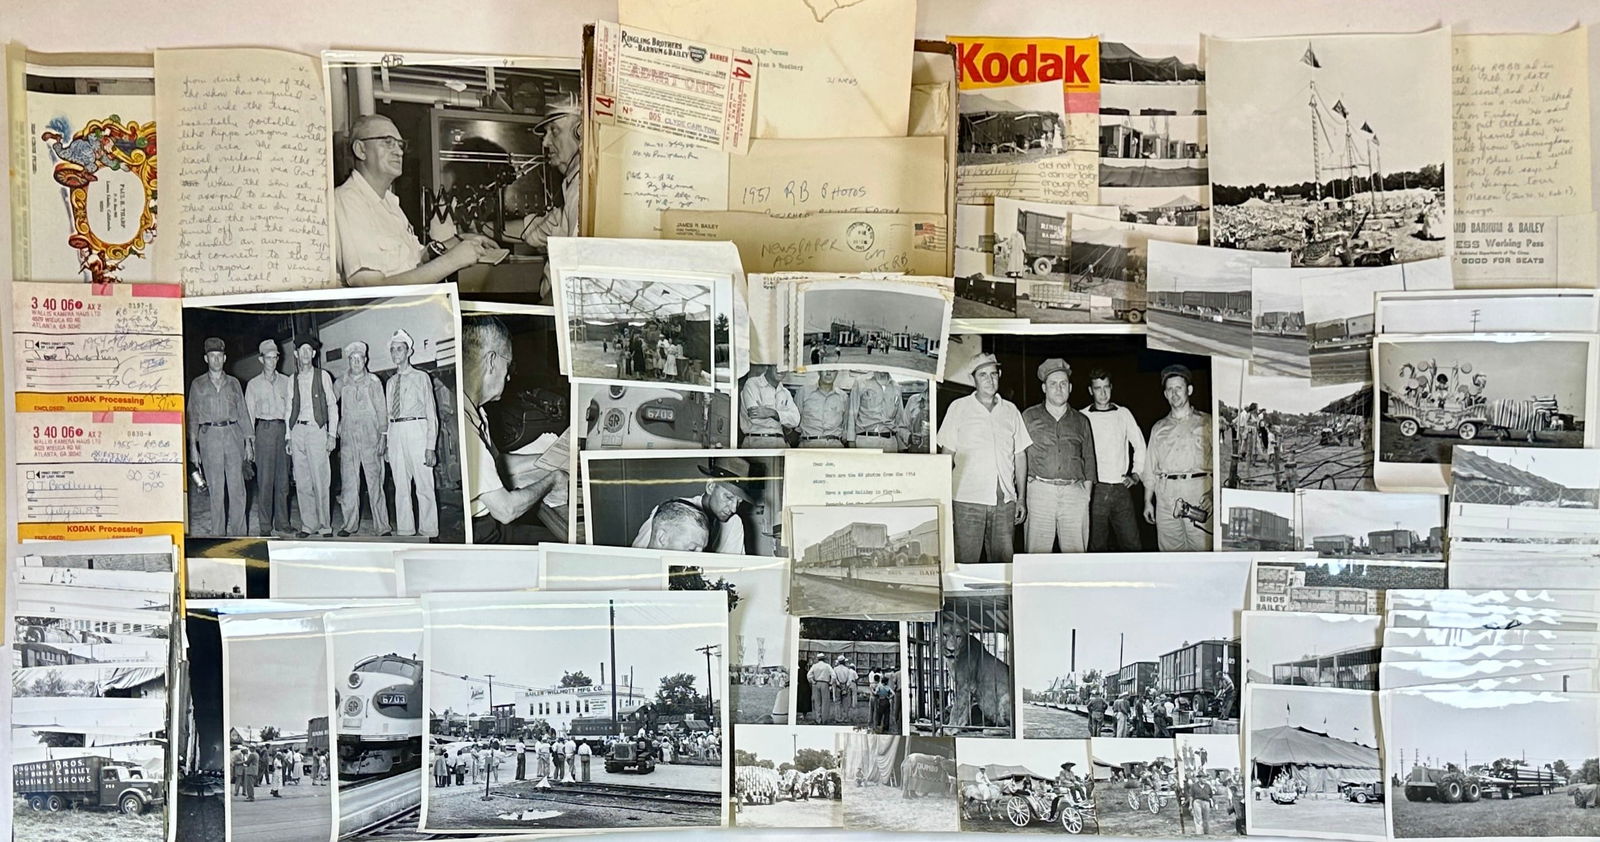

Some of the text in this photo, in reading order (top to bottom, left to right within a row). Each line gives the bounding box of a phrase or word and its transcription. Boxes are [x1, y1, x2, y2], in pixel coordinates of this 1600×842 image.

[621, 31, 682, 50] RINGLING BROTHERS
[668, 49, 690, 59] BAILEY
[732, 58, 753, 79] 14
[959, 42, 1090, 84] Kodak
[595, 96, 615, 118] 14
[1471, 222, 1545, 233] BARNUM & BAILEY
[1485, 238, 1522, 249] Working
[1526, 239, 1544, 248] Pass
[31, 297, 39, 310] 3
[43, 298, 57, 311] 40
[99, 396, 145, 405] Processing
[648, 408, 674, 419] 6703
[33, 426, 40, 438] 3
[44, 426, 57, 438] 40
[99, 526, 144, 534] Processing
[382, 695, 406, 704] 6703
[64, 767, 91, 775] BAILEY
[15, 775, 92, 786] COMBINED SHOWS
